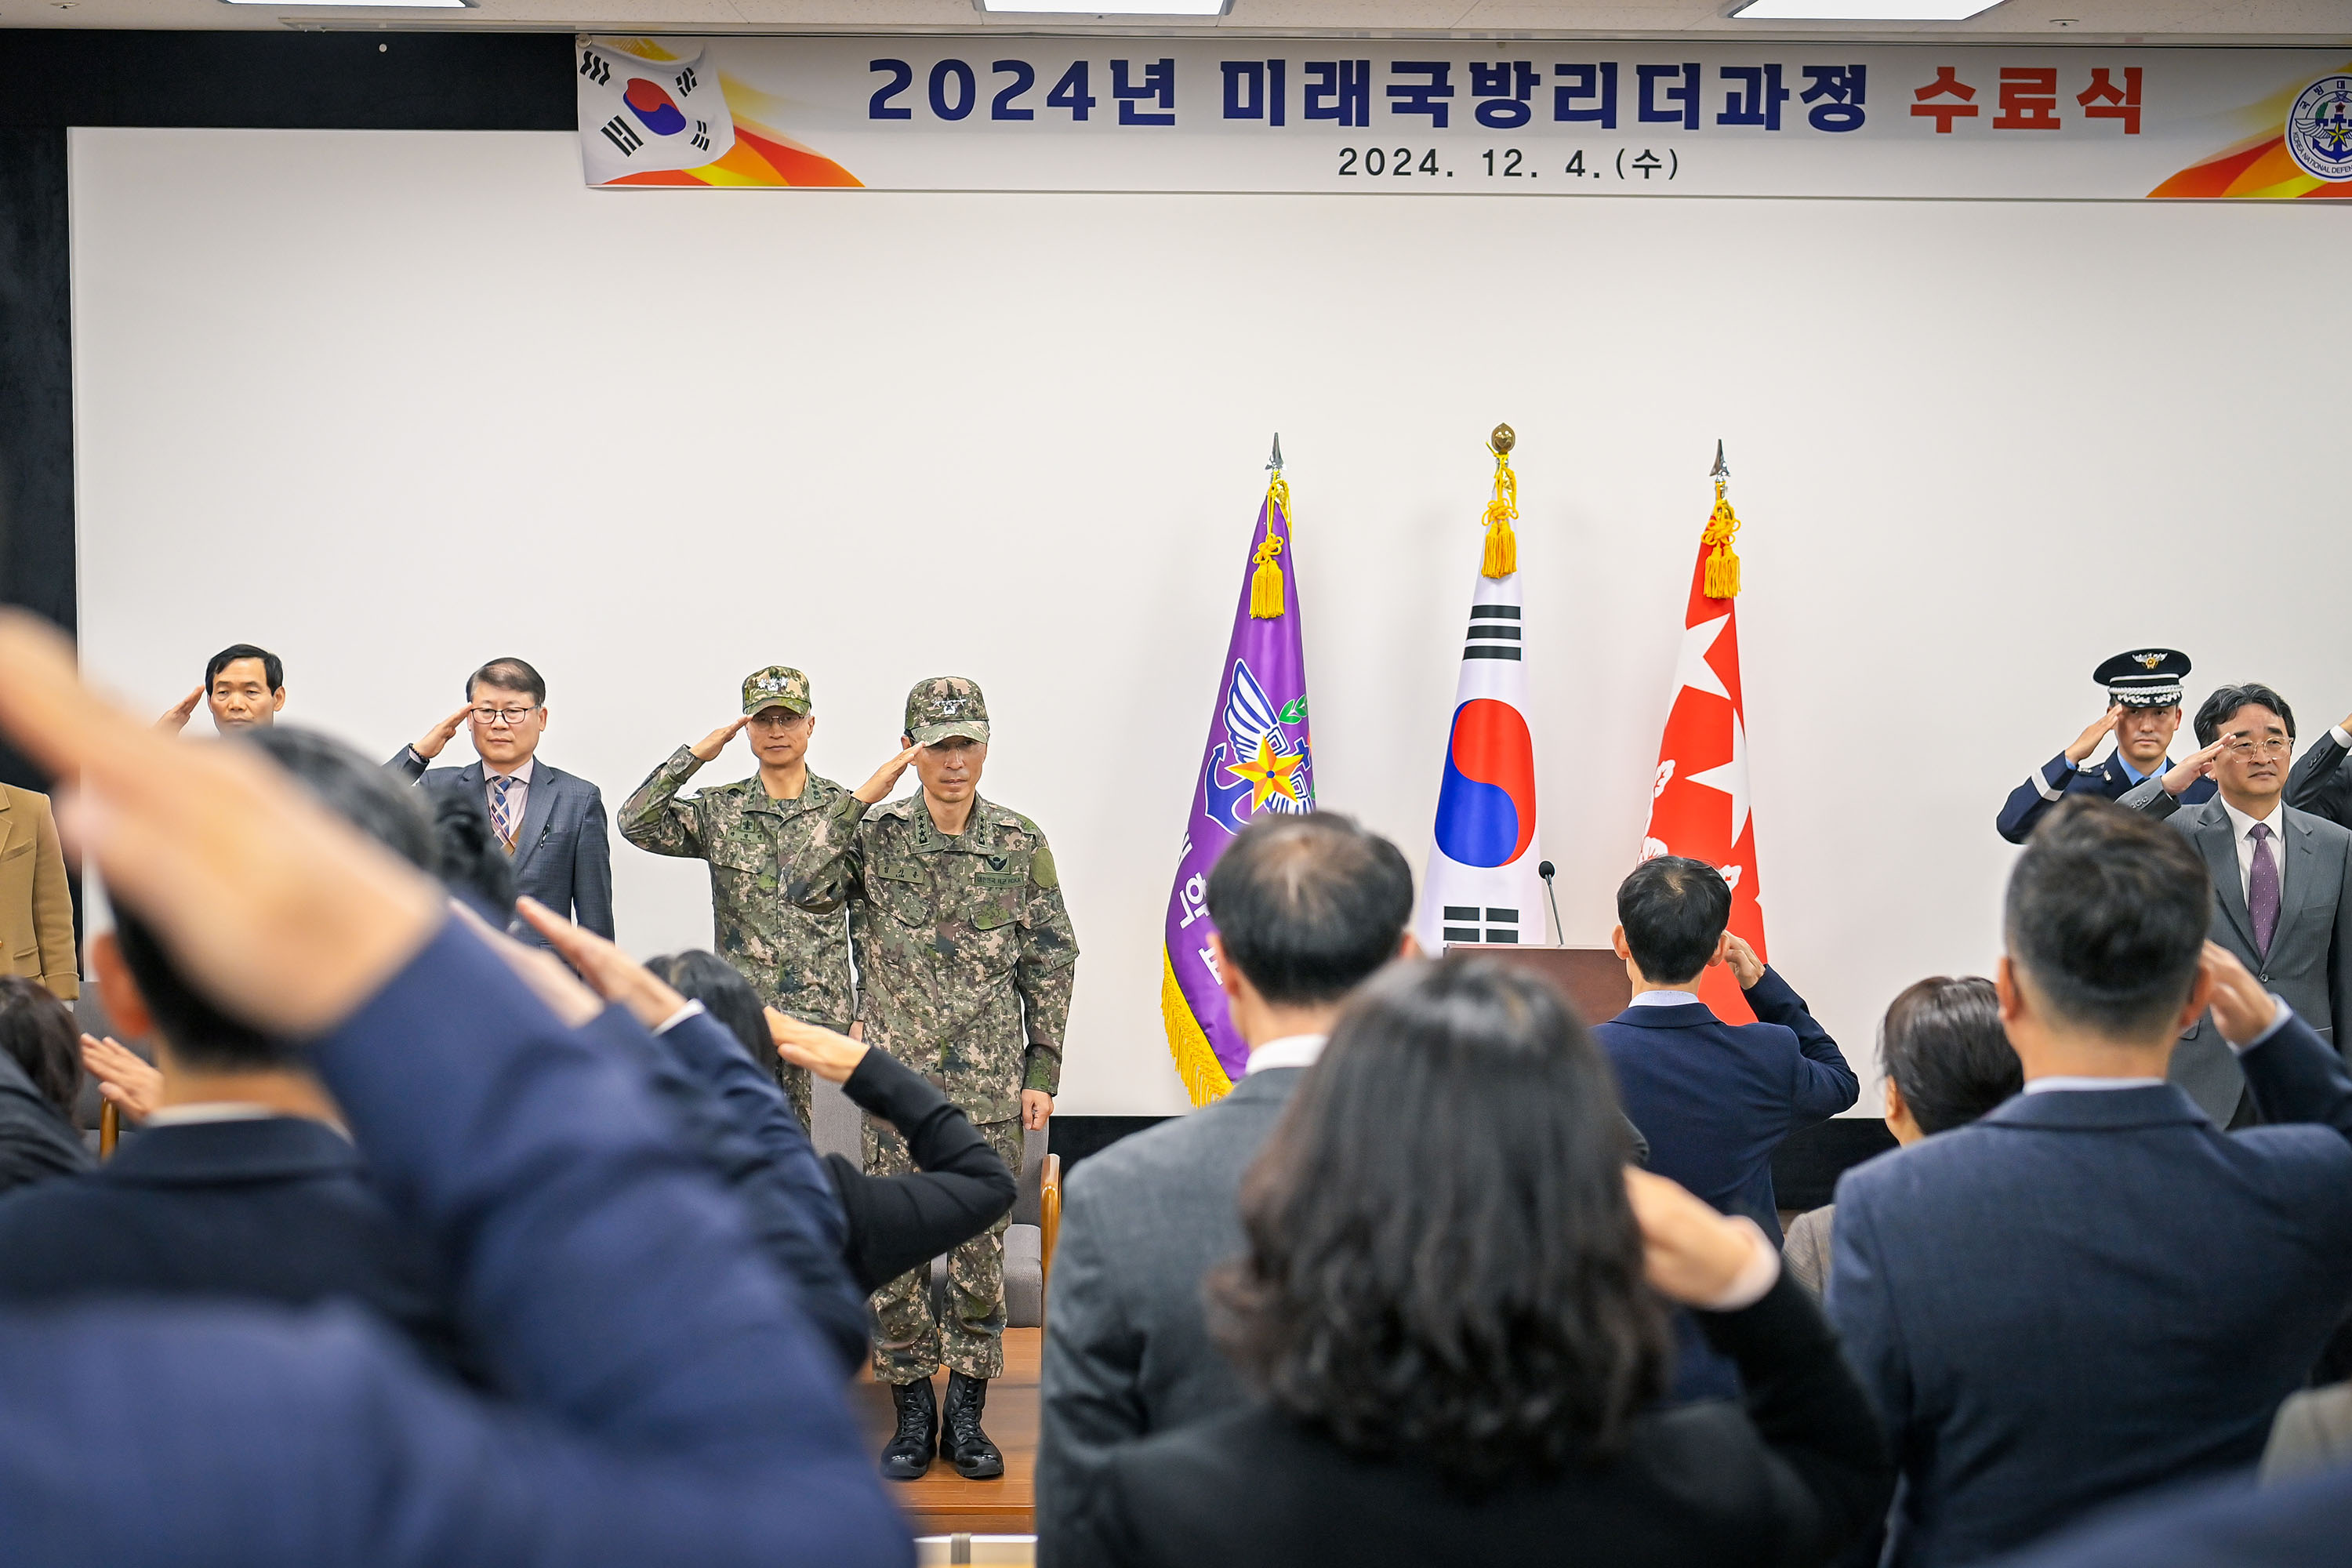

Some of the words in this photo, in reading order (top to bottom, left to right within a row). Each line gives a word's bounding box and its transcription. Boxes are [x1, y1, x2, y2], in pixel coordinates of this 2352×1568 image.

[868, 58, 1176, 126] 2024년
[1220, 59, 1867, 132] 미래국방리더과정
[1911, 67, 2142, 134] 수료식
[1338, 147, 1454, 178] 2024.
[1482, 148, 1537, 179] 12.
[2302, 153, 2330, 173] NATIONAL
